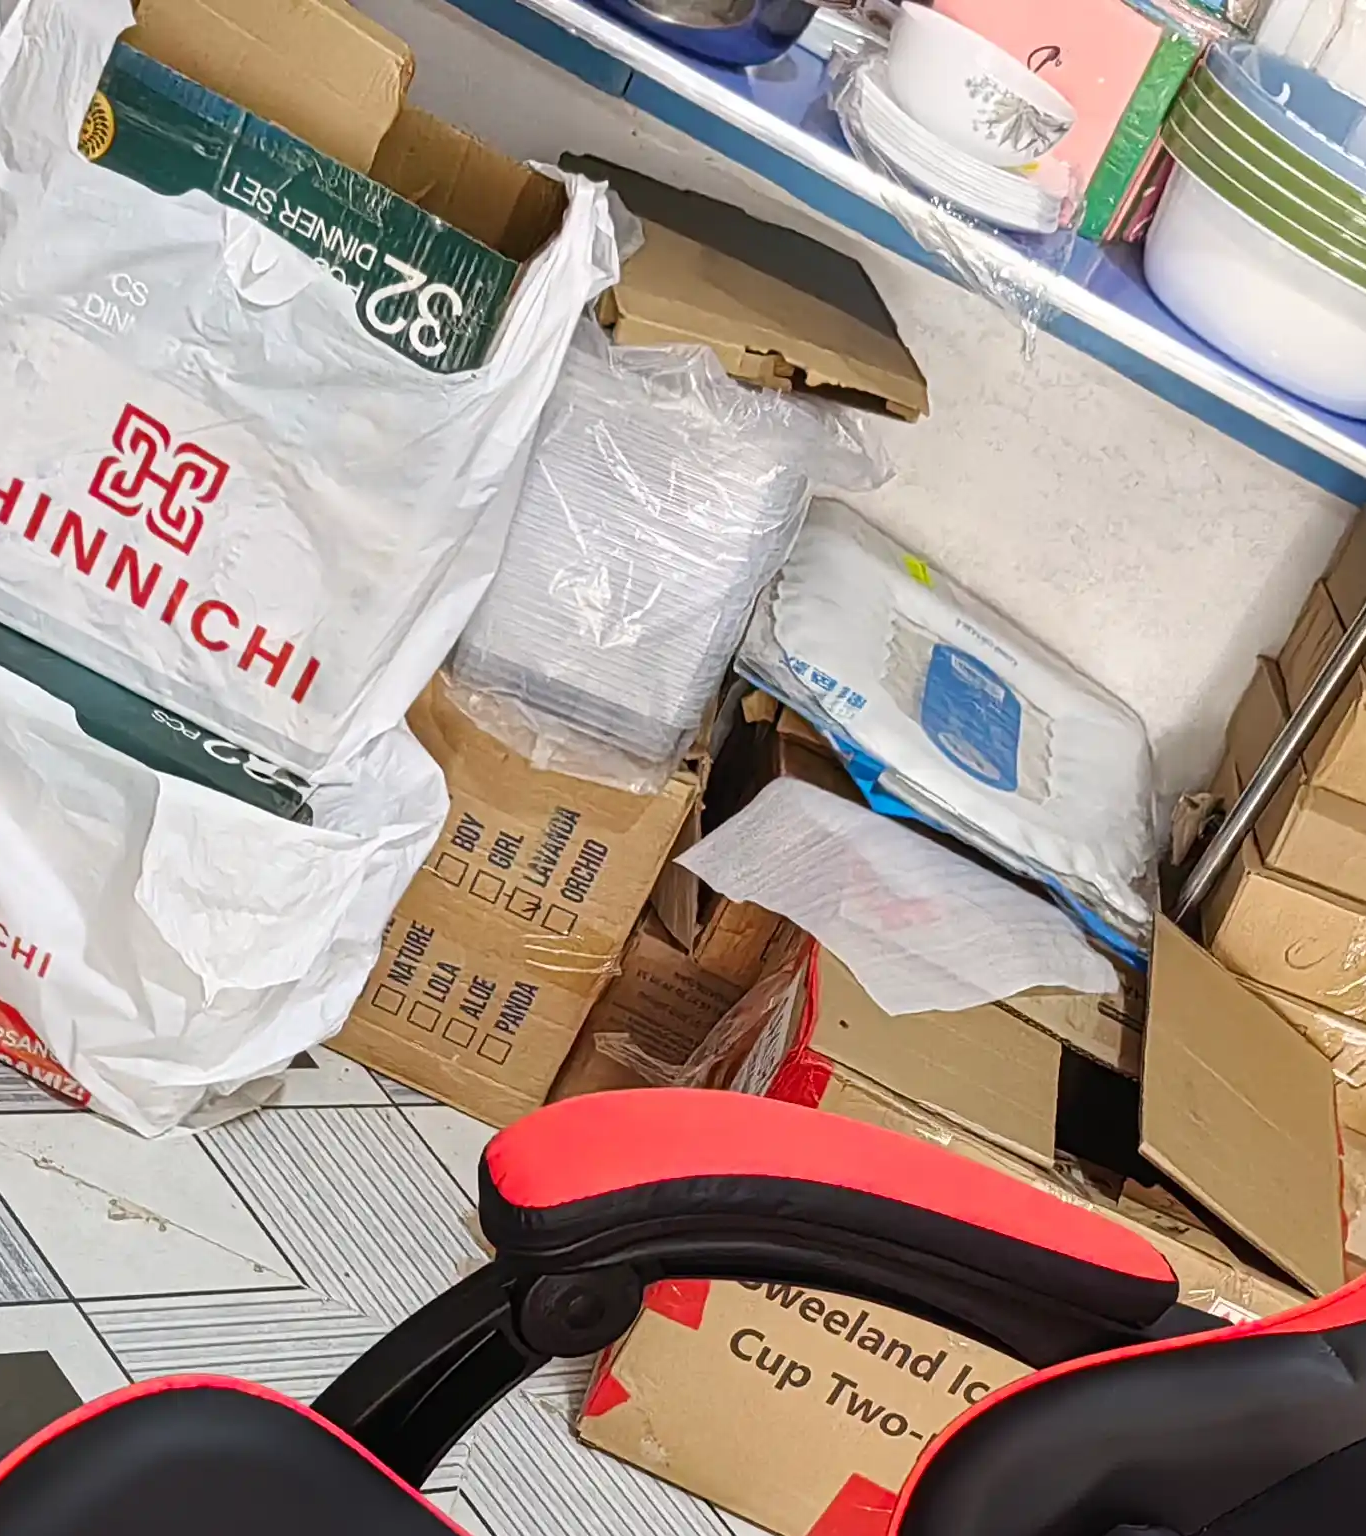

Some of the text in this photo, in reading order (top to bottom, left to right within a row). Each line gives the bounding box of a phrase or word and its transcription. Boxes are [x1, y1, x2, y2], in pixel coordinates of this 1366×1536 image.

[223, 171, 378, 271] DINNER SET
[366, 254, 463, 357] 32
[151, 709, 202, 741] PCS
[451, 812, 485, 854] BOY
[487, 830, 525, 870] GIRL
[523, 805, 581, 888] LAVANDA
[560, 838, 610, 903] ORCHID
[387, 919, 435, 987] NATURE
[422, 960, 462, 1004] LOLA
[459, 975, 497, 1021] ALOE
[493, 980, 539, 1035] PANDA
[729, 1328, 812, 1391] Cup
